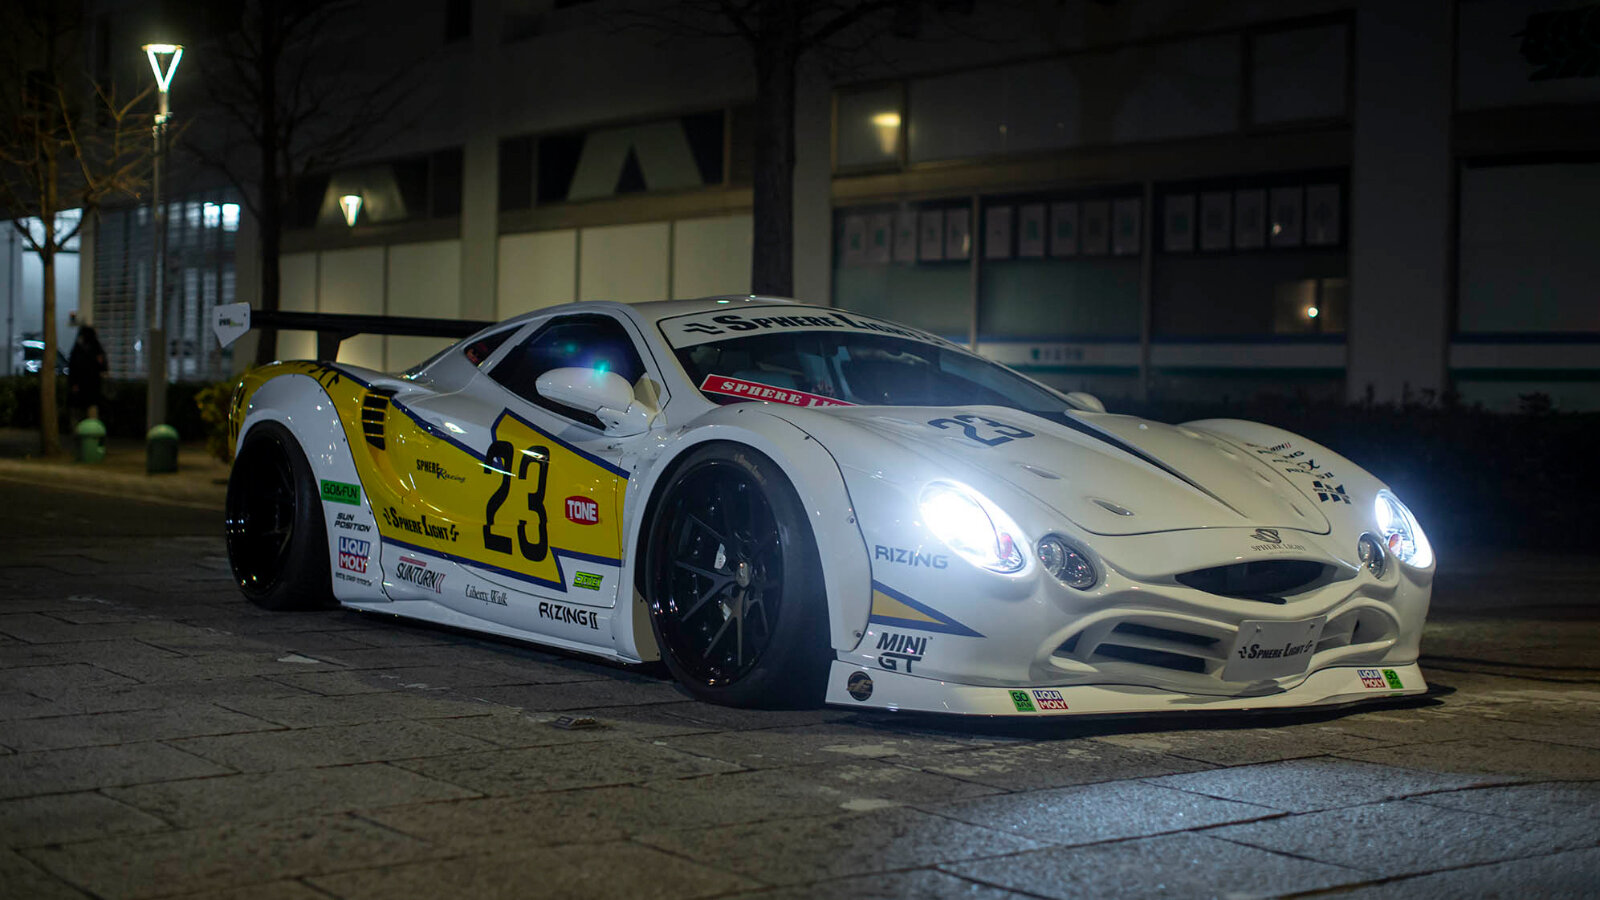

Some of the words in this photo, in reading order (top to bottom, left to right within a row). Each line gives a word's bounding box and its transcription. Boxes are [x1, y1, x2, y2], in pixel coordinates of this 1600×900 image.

[713, 315, 844, 331] SPHERE
[720, 380, 802, 404] SPHERE
[928, 414, 1035, 447] 23
[416, 459, 440, 473] SPHERE
[323, 483, 358, 499] GO&FUN
[483, 440, 550, 562] 23
[337, 512, 355, 522] SUN
[567, 500, 598, 522] TONE
[334, 521, 371, 533] POSITION
[389, 507, 423, 535] SPHERE
[421, 515, 450, 541] LIGHT
[340, 537, 369, 557] LIQUI
[340, 554, 367, 573] MOLY
[874, 544, 949, 570] RIZING
[876, 632, 928, 656] MINI
[1247, 643, 1284, 659] SPHERE
[878, 652, 922, 673] GT
[1358, 670, 1381, 679] LIQUI
[1364, 679, 1385, 688] MOLY
[1012, 692, 1029, 702] GO
[1033, 690, 1061, 700] LIQUI
[1039, 700, 1066, 709] MOLY
